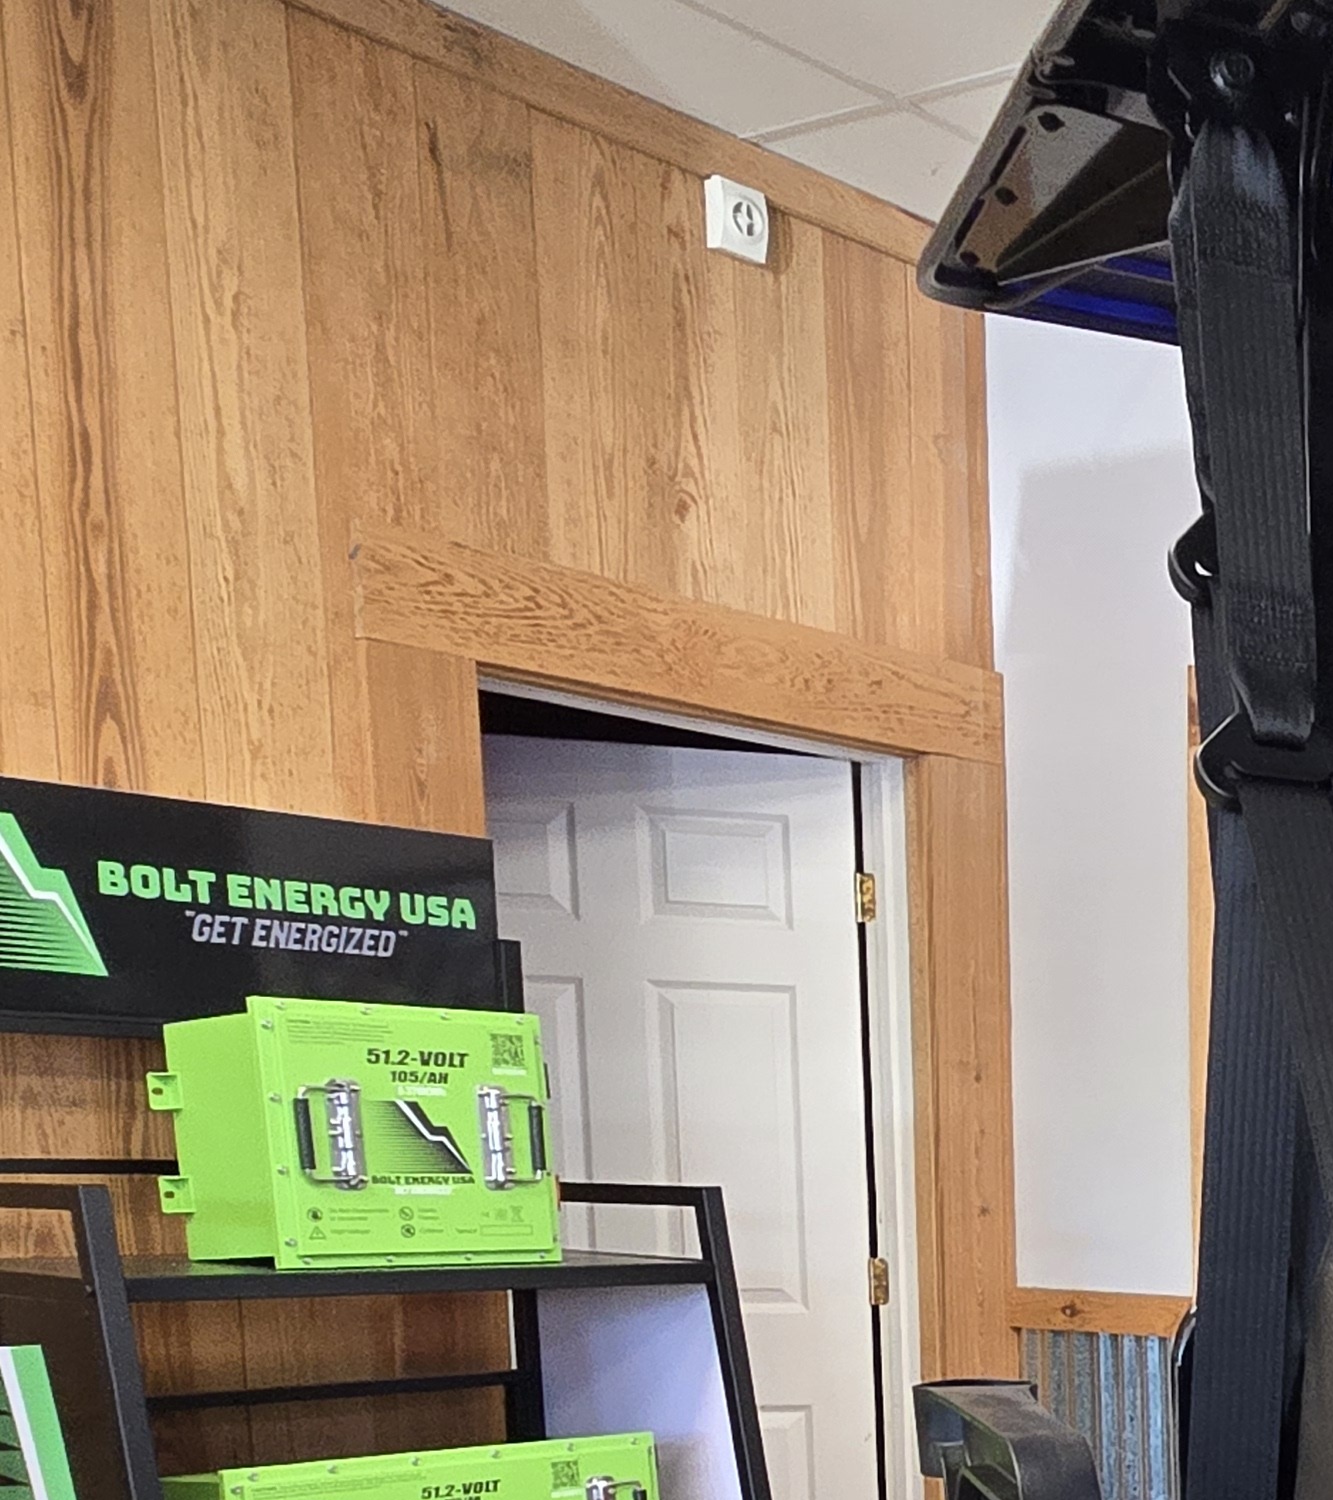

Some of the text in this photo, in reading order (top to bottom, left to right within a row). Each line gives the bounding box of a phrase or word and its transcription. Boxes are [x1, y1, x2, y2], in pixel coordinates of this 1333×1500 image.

[98, 860, 476, 930] BOLT ENERGY USA
[366, 1048, 469, 1069] 51.2-VOLT
[390, 1071, 449, 1085] 105/AH
[371, 1175, 402, 1185] BOLT
[421, 1479, 501, 1500] 51.2-VOLT
